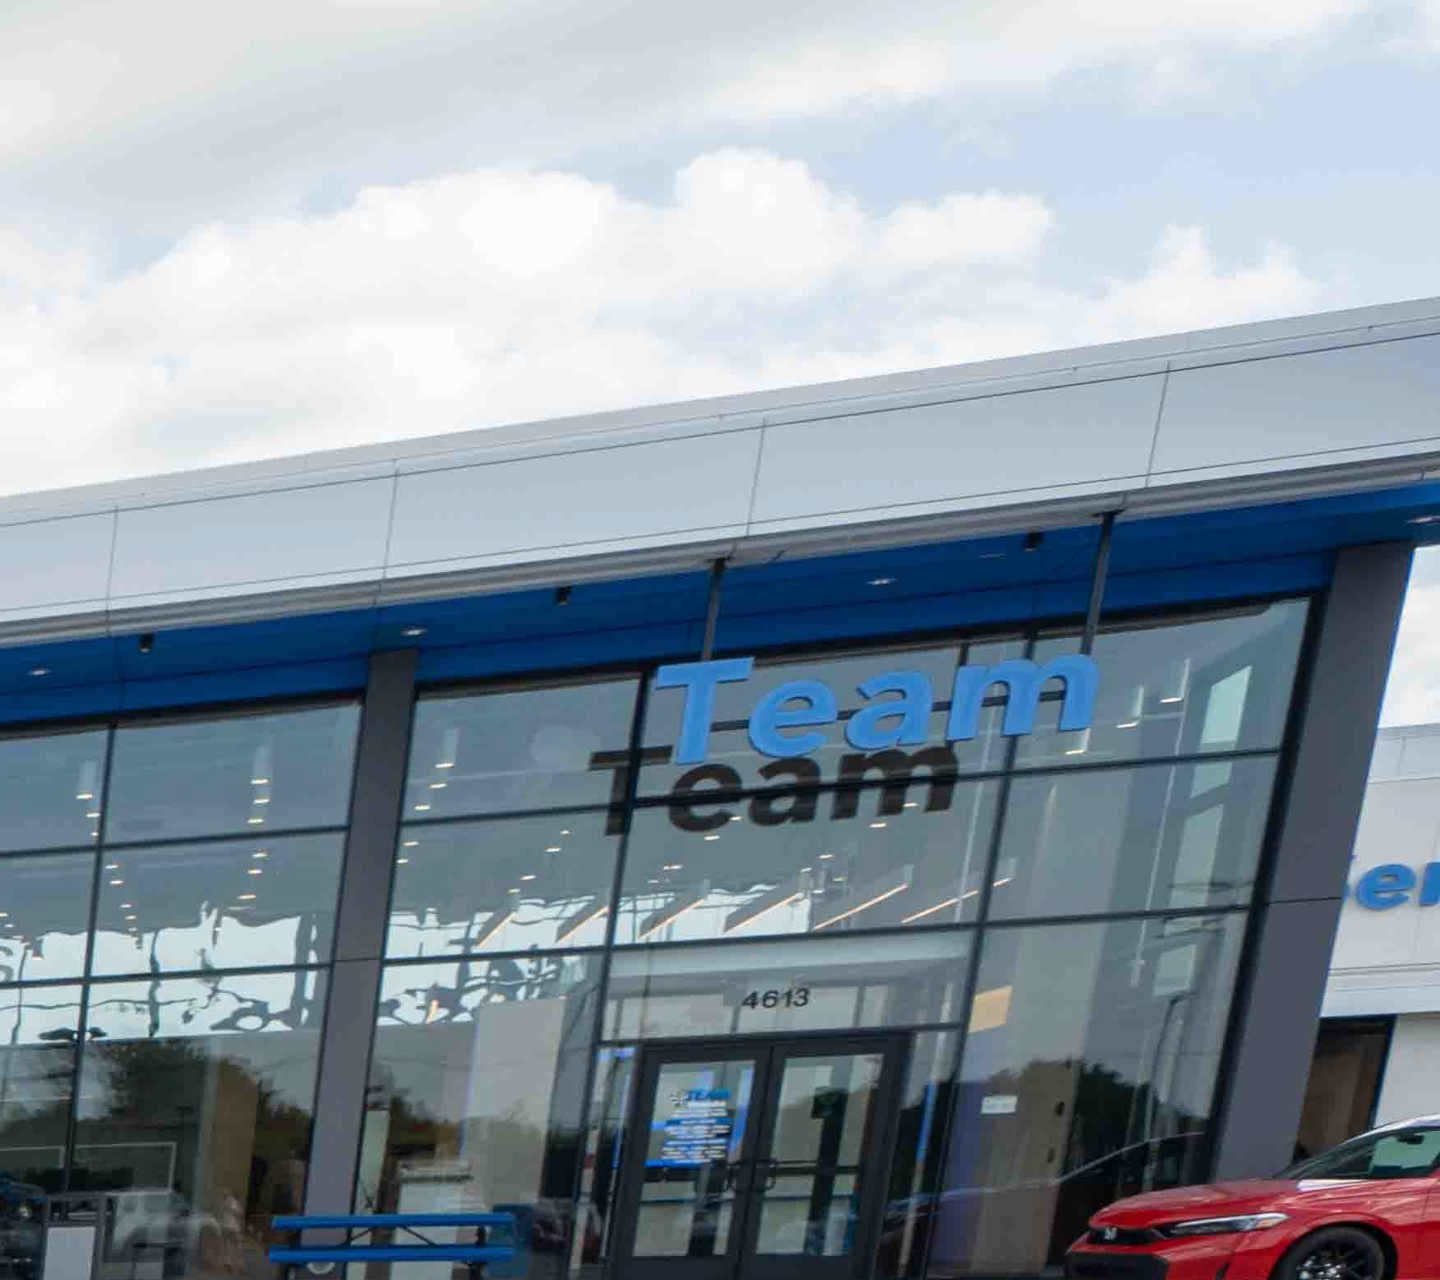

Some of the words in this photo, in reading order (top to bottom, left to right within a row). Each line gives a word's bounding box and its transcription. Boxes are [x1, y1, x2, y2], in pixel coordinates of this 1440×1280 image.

[655, 653, 1100, 766] Team
[588, 745, 960, 836] Team
[741, 987, 810, 1010] 4613
